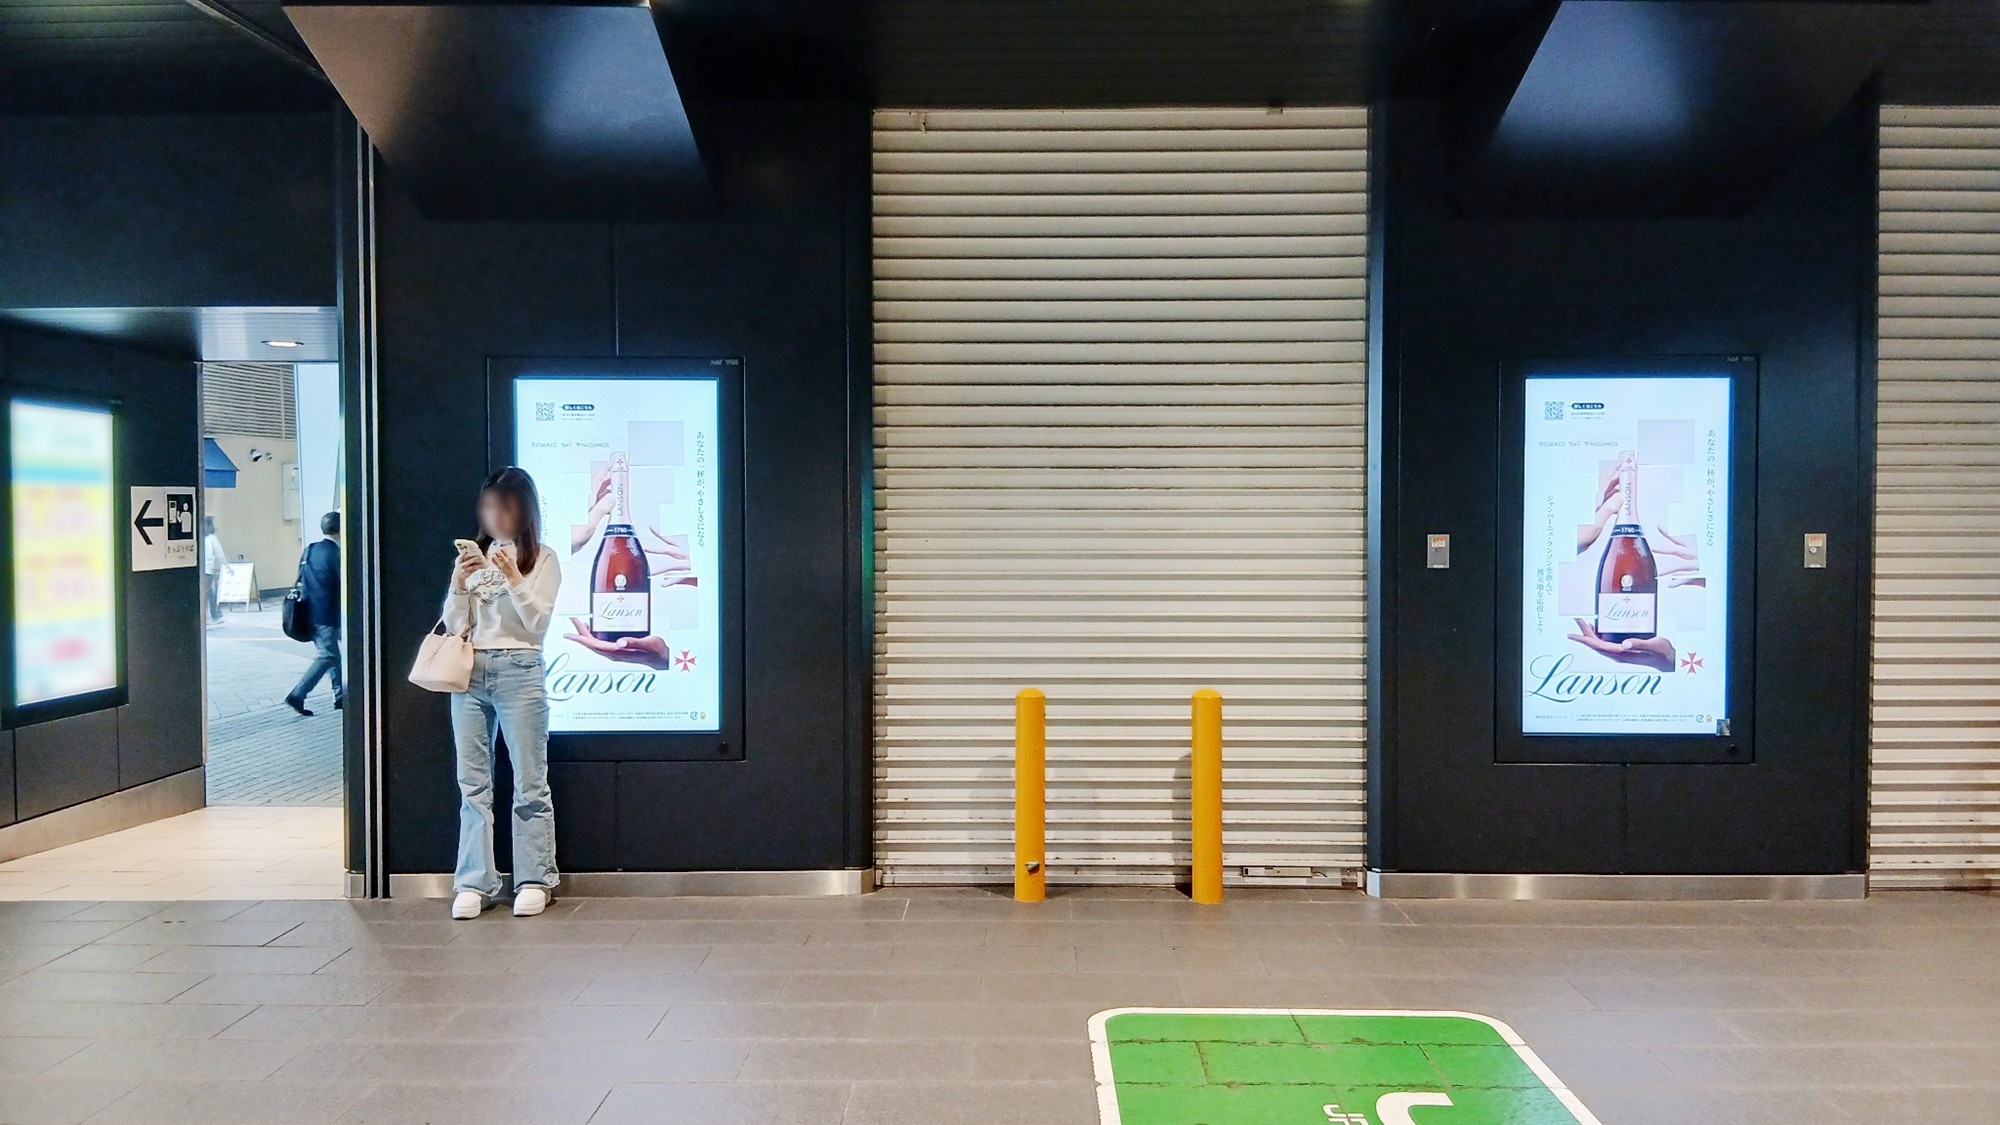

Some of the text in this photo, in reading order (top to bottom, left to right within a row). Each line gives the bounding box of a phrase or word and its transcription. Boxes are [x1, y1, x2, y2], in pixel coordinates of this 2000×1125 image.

[616, 483, 624, 517] LANSON
[599, 600, 643, 621] Lanson
[1604, 602, 1650, 621] Lanson
[1524, 653, 1662, 703] Lanson
